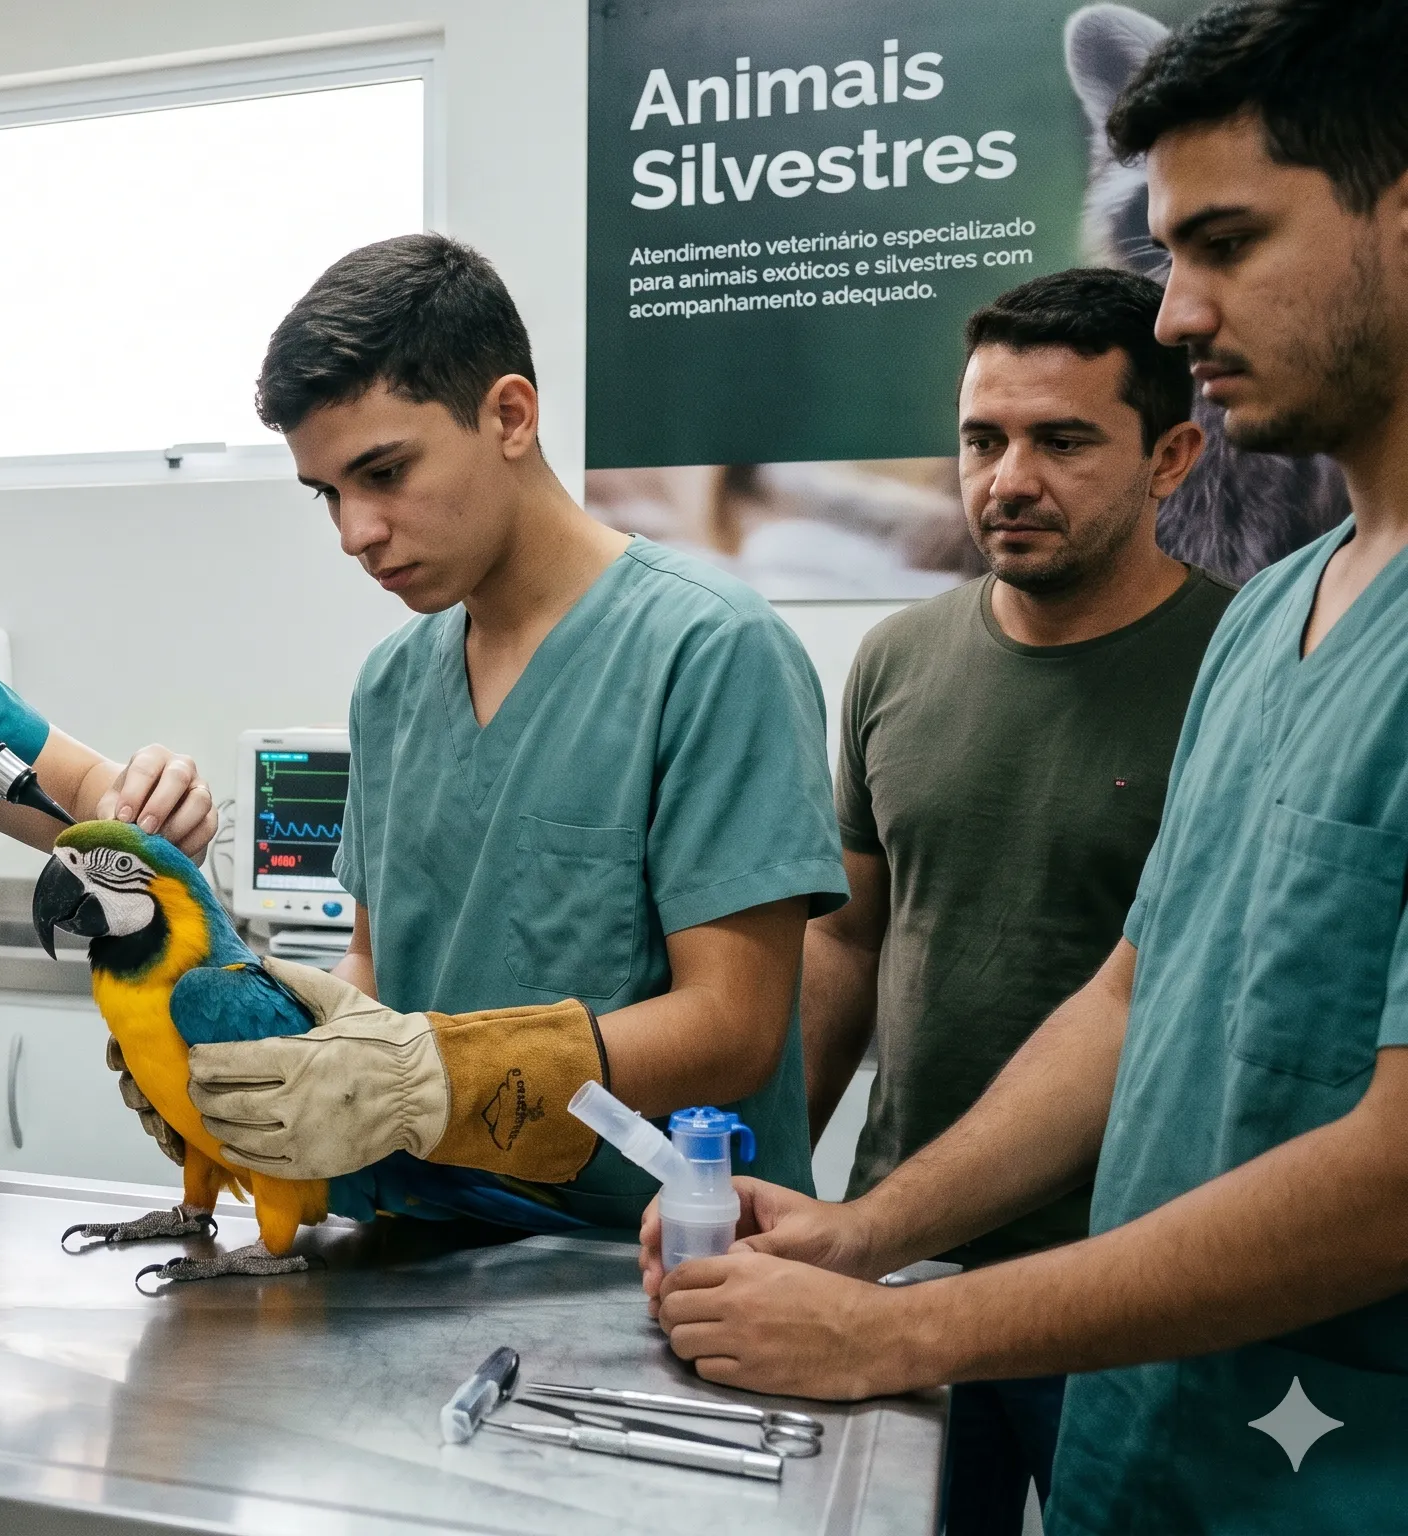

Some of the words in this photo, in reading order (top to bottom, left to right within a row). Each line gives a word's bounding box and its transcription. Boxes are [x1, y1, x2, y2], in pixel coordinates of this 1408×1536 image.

[629, 38, 944, 131] Animais
[629, 127, 1018, 210] Silvestres
[629, 238, 761, 266] Atendimento
[765, 229, 878, 255] veterinário
[882, 216, 1036, 249] especializado
[629, 274, 674, 296] para
[678, 265, 758, 289] animais
[762, 260, 850, 283] exóticos
[855, 260, 870, 276] e
[874, 251, 977, 275] silvestres
[982, 248, 1033, 267] com
[629, 289, 817, 319] acompanhamento
[821, 280, 937, 307] adequado.
